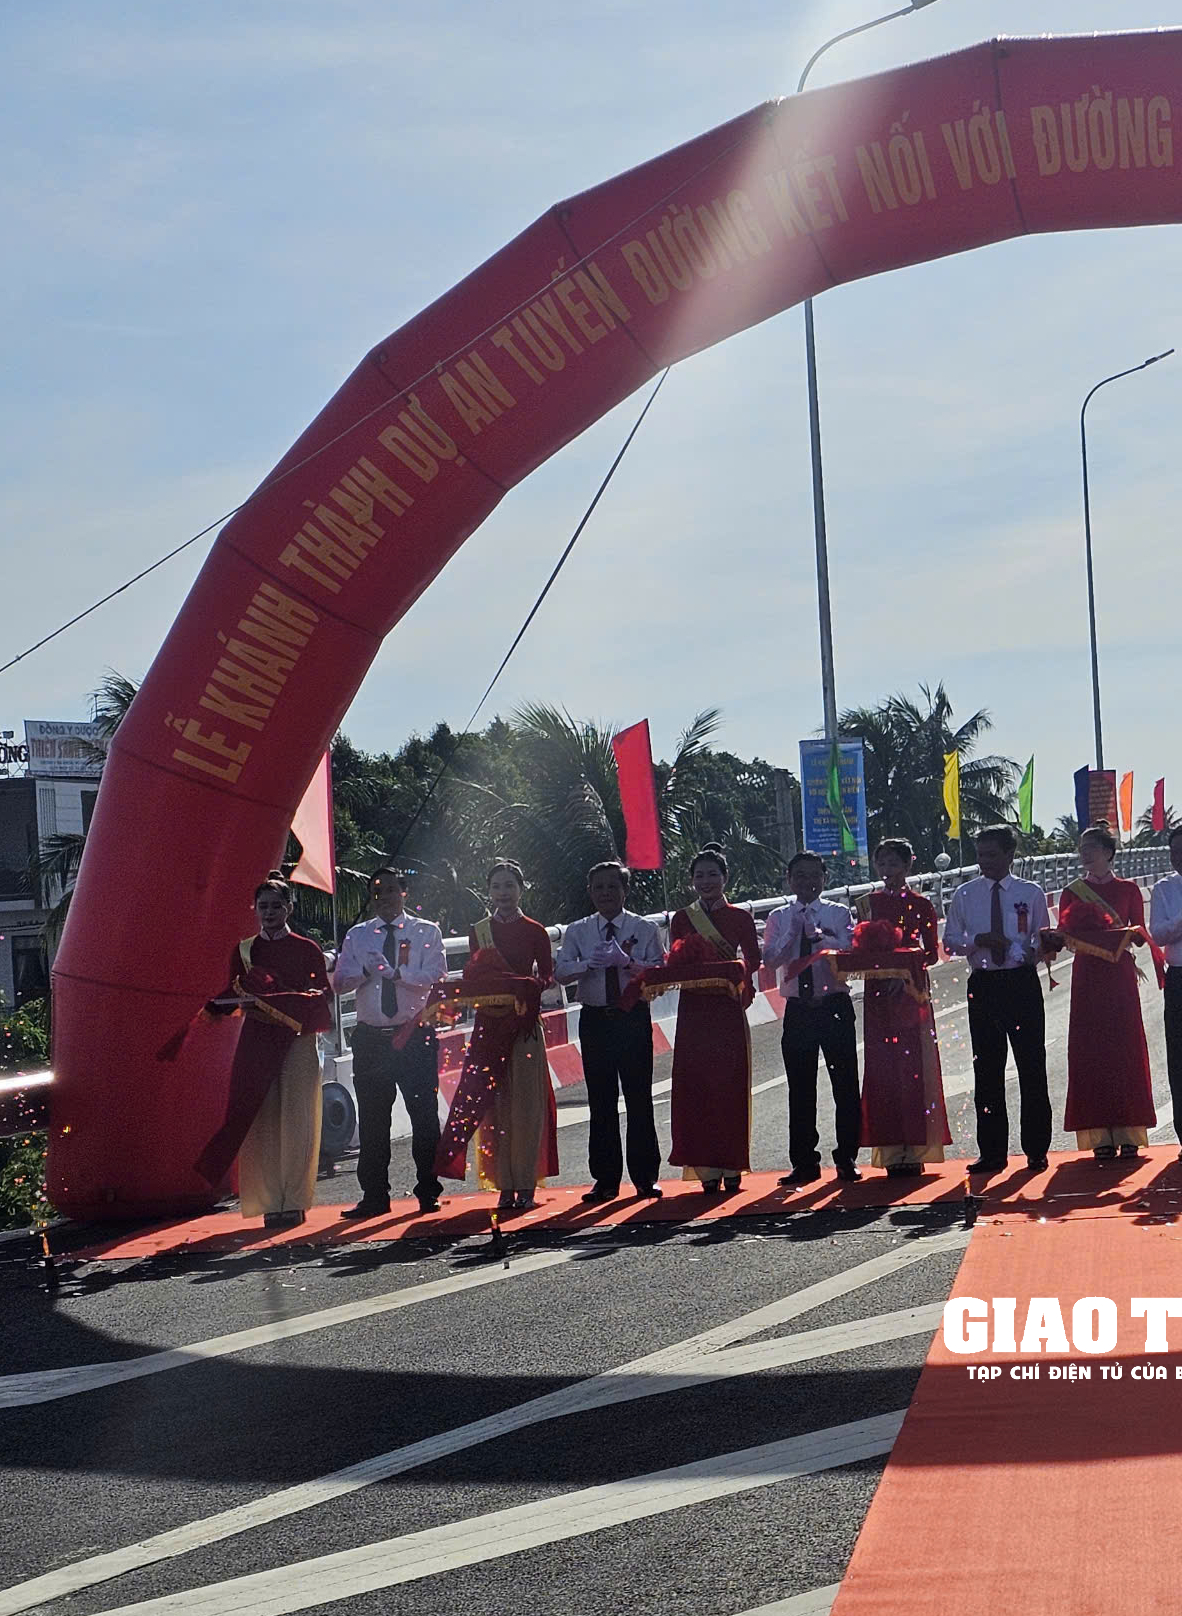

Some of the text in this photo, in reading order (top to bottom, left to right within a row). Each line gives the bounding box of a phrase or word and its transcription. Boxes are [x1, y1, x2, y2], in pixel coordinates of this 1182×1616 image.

[855, 109, 938, 214] NỐI
[941, 99, 1018, 190] VỚI
[1030, 84, 1175, 176] ĐƯỜNG
[620, 188, 772, 307] ĐƯỜNG
[491, 256, 632, 385] TUYẾN
[377, 392, 467, 484] DỰ
[278, 455, 415, 595] THÀNH
[199, 582, 320, 731] KHÁNH
[165, 711, 252, 784] LỄ
